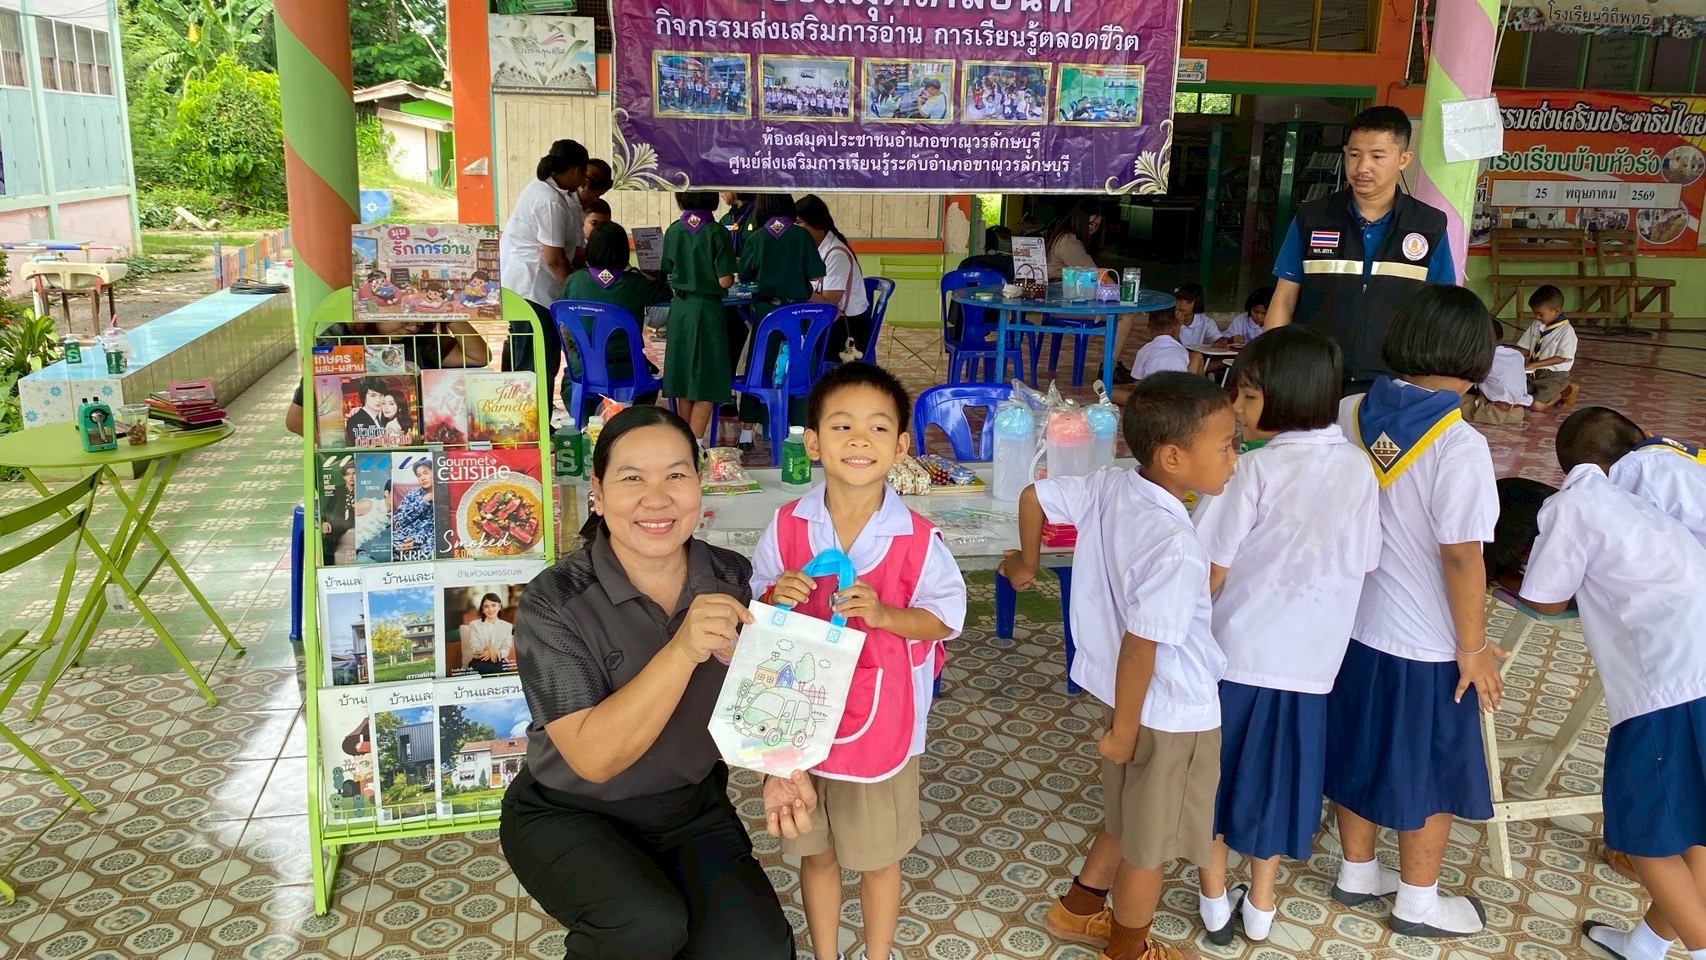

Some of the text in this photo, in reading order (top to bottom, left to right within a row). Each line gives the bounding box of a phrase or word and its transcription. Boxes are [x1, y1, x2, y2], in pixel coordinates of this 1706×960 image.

[655, 12, 1139, 56] กิจกรรมส่งเสริมการอ่าน การเรียนรู้ตลอดชีวิต
[762, 127, 1041, 153] ห้องสมุดประชาชนอำเภอขาณุวรลักษบุรี
[729, 150, 1070, 177] ศูนย์ส่งเสริมการเรียนรู้ระดับอำเภอขาณุวรลักษบุรี
[1535, 187, 1548, 199] 25
[1565, 187, 1617, 203] พฤษภาคม
[1631, 189, 1655, 201] 2569
[391, 228, 406, 239] มุม
[393, 240, 471, 256] รักการอ่าน
[315, 354, 351, 365] เกษตร
[315, 364, 364, 373] ผสม-ผสาน
[492, 384, 521, 404] Jill
[476, 399, 528, 413] Barnett
[437, 456, 489, 467] Gourmet
[437, 465, 511, 480] cuisine
[439, 530, 512, 553] Smoked
[454, 684, 524, 699] บ้านและสวน
